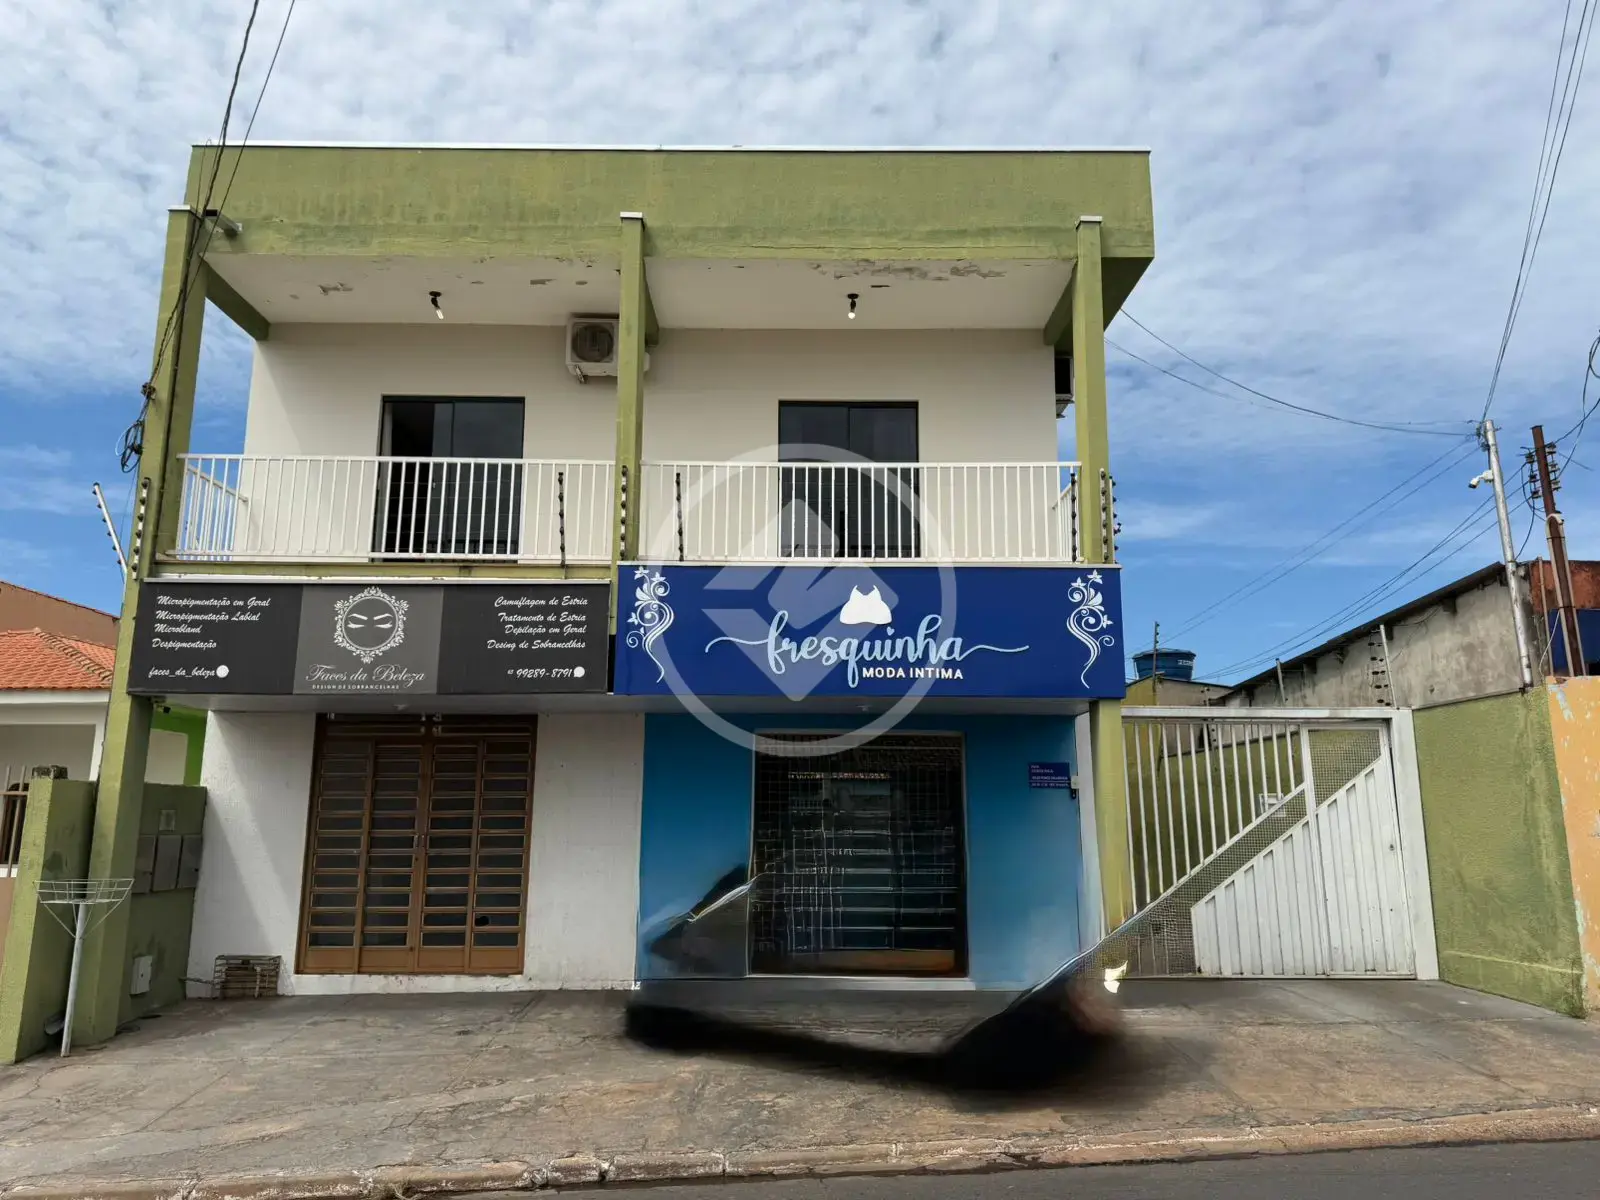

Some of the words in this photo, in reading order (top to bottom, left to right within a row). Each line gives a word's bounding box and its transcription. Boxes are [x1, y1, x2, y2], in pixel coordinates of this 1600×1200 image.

[157, 595, 231, 608] Micropigmentação
[247, 596, 271, 609] Geral
[494, 596, 546, 608] Camuflagem
[549, 597, 559, 605] de
[561, 595, 588, 606] Estria
[156, 609, 229, 623] Micropigmentação
[231, 611, 261, 621] Labial
[498, 612, 544, 622] Tratamento
[547, 613, 557, 621] de
[560, 611, 587, 622] Estria
[154, 623, 203, 633] Microbland
[505, 624, 546, 636] Depilação
[563, 623, 587, 636] Geral
[152, 638, 217, 651] Despigmentação
[486, 639, 516, 652] Desing
[518, 640, 529, 649] de
[531, 639, 586, 650] Sobrancelhas
[766, 610, 966, 689] fresquinha
[305, 664, 347, 681] Faces
[349, 667, 368, 681] da
[372, 663, 426, 689] Beleza
[516, 668, 573, 678] 99289-8791
[862, 667, 906, 679] MODA
[909, 667, 964, 680] INTIMA
